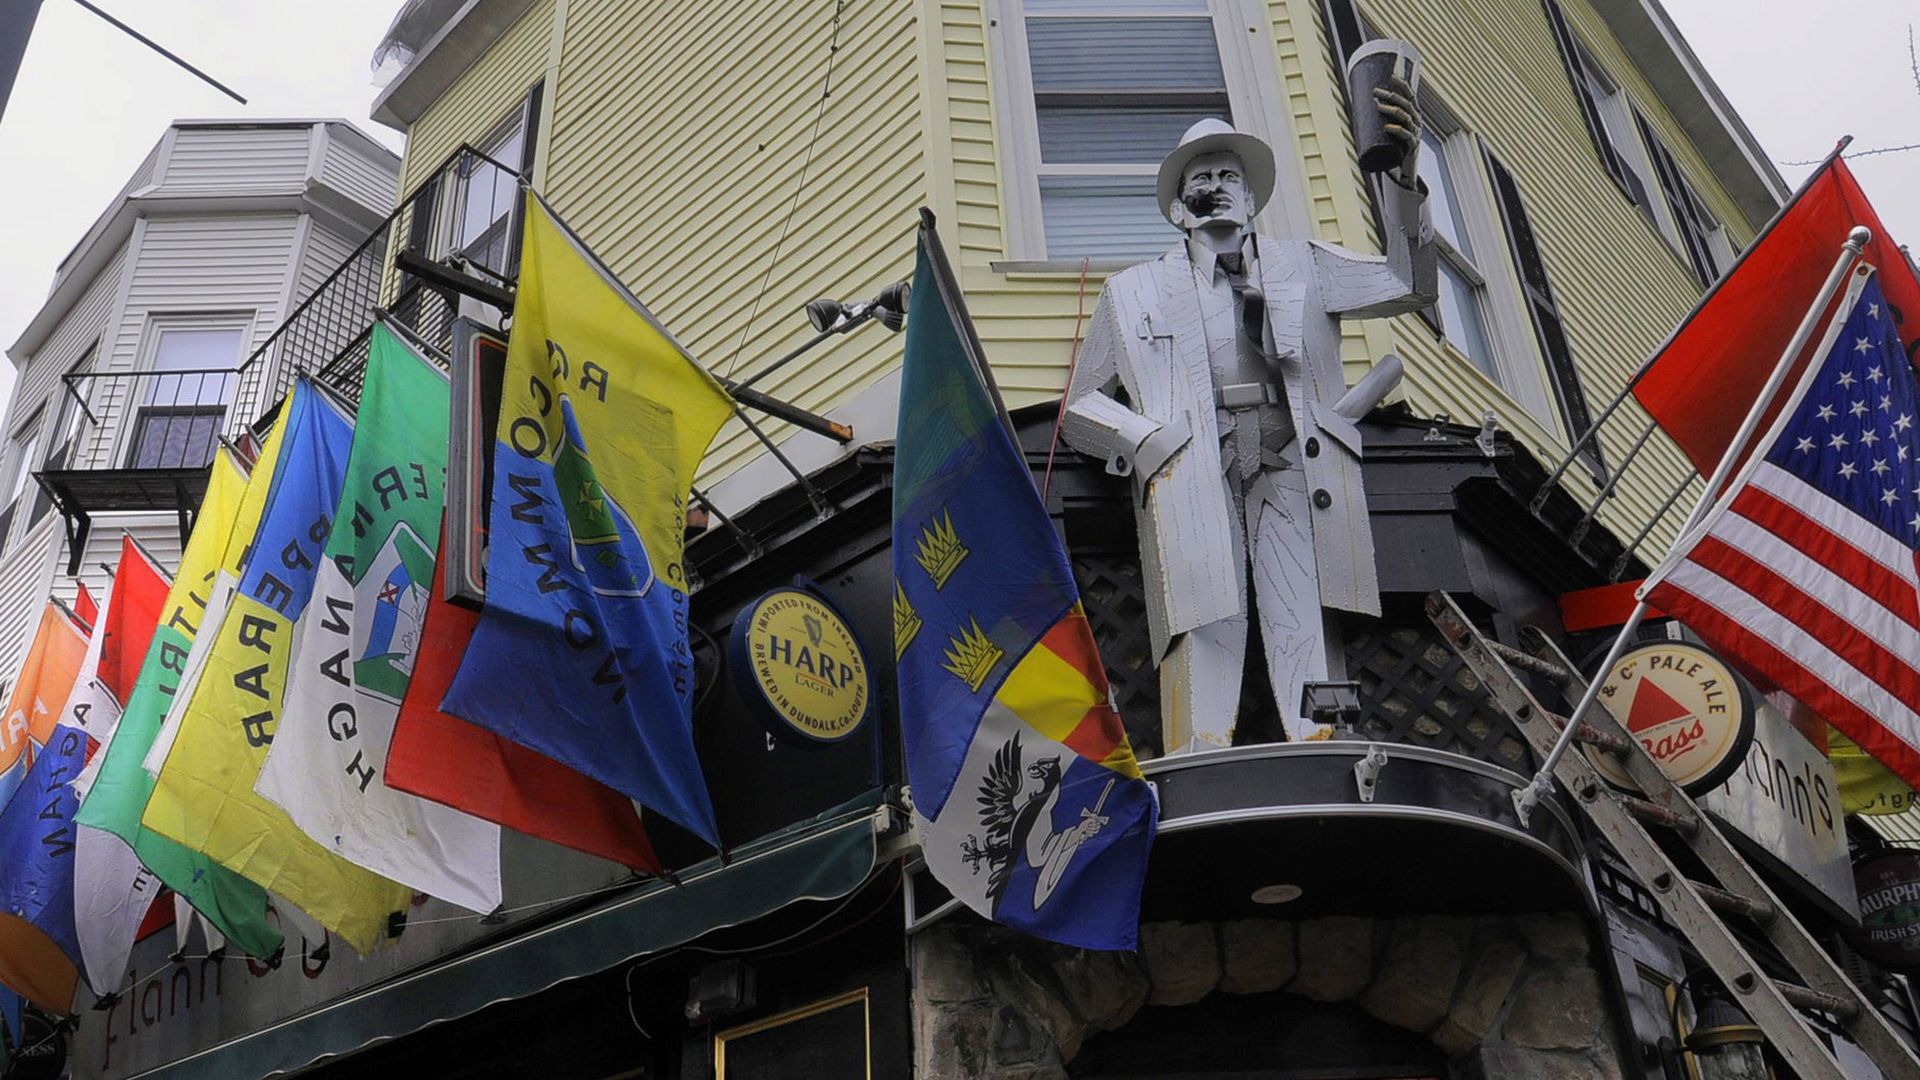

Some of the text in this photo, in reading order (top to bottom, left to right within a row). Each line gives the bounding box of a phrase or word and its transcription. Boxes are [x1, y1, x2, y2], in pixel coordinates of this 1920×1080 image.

[756, 599, 798, 633] IMPORTED
[832, 621, 861, 674] IRELAND
[770, 634, 854, 688] HARP
[755, 643, 779, 694] BREWED
[776, 695, 789, 709] IN
[795, 674, 835, 698] LAGER
[1650, 656, 1703, 678] PALE
[1700, 679, 1726, 714] ALE
[1871, 927, 1907, 942] IRISH
